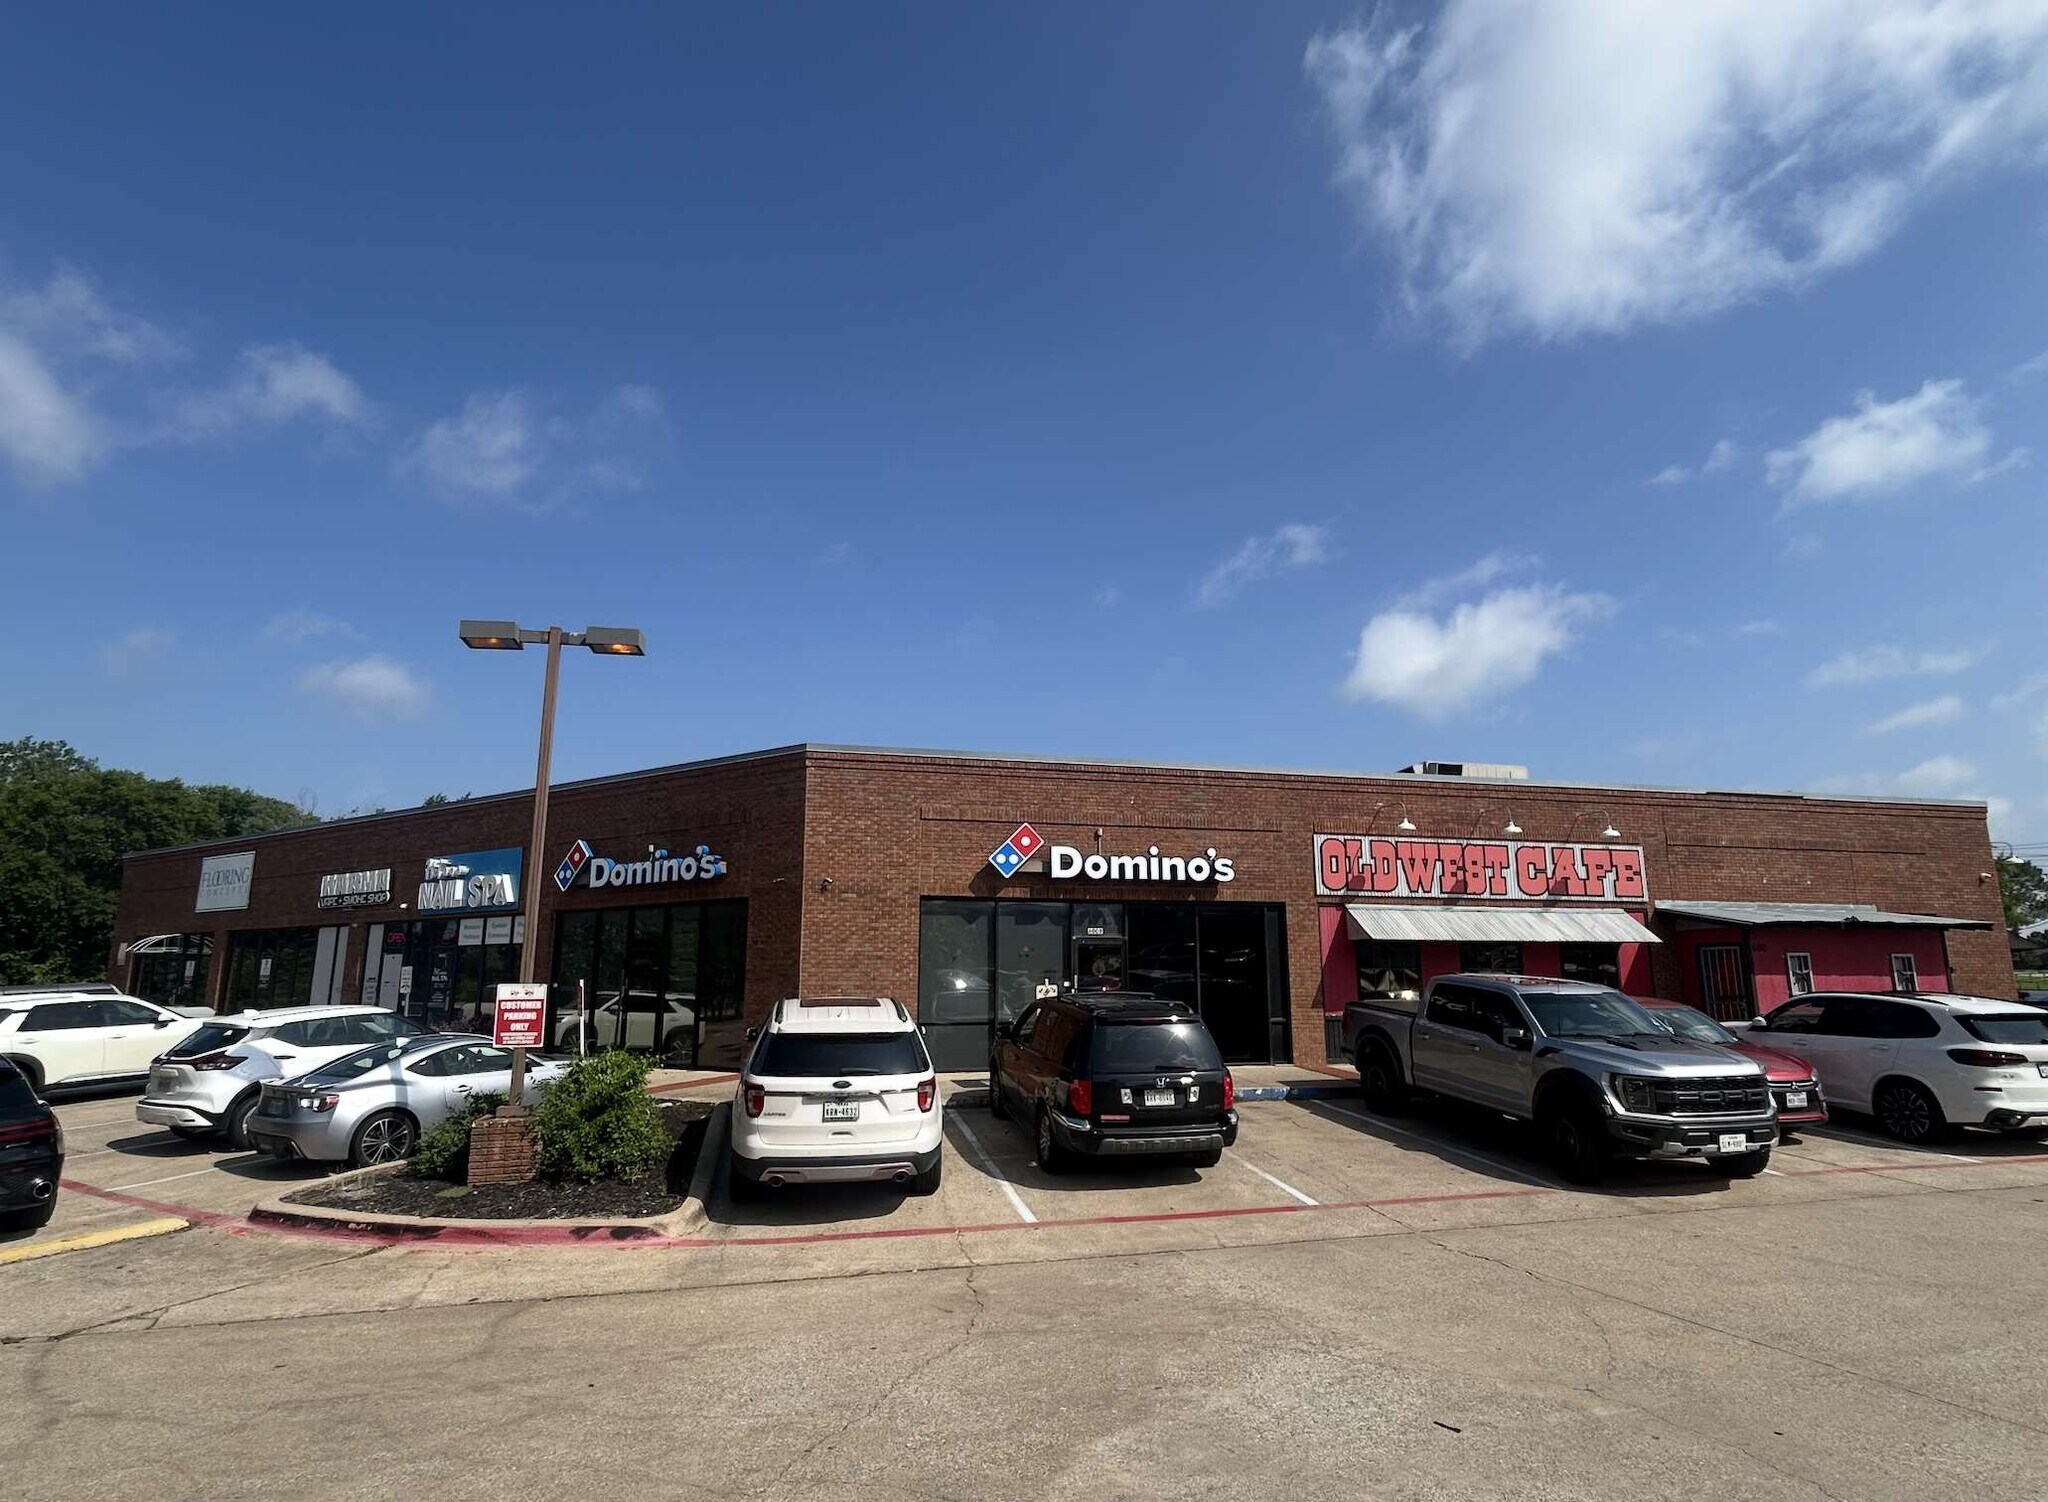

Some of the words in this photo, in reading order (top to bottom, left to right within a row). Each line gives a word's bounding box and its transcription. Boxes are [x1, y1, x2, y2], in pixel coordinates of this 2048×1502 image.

[589, 845, 720, 888] Domino's
[1050, 845, 1236, 882] Domino's
[1515, 845, 1645, 898] CAFE
[202, 867, 250, 888] FLOORING
[320, 868, 391, 897] KARMA
[367, 891, 387, 904] SHOP
[417, 879, 464, 910] NAIL
[467, 873, 515, 908] SPA
[500, 1000, 542, 1010] CUSTOMER
[503, 1011, 537, 1021] PARKING
[510, 1022, 530, 1031] ONLY
